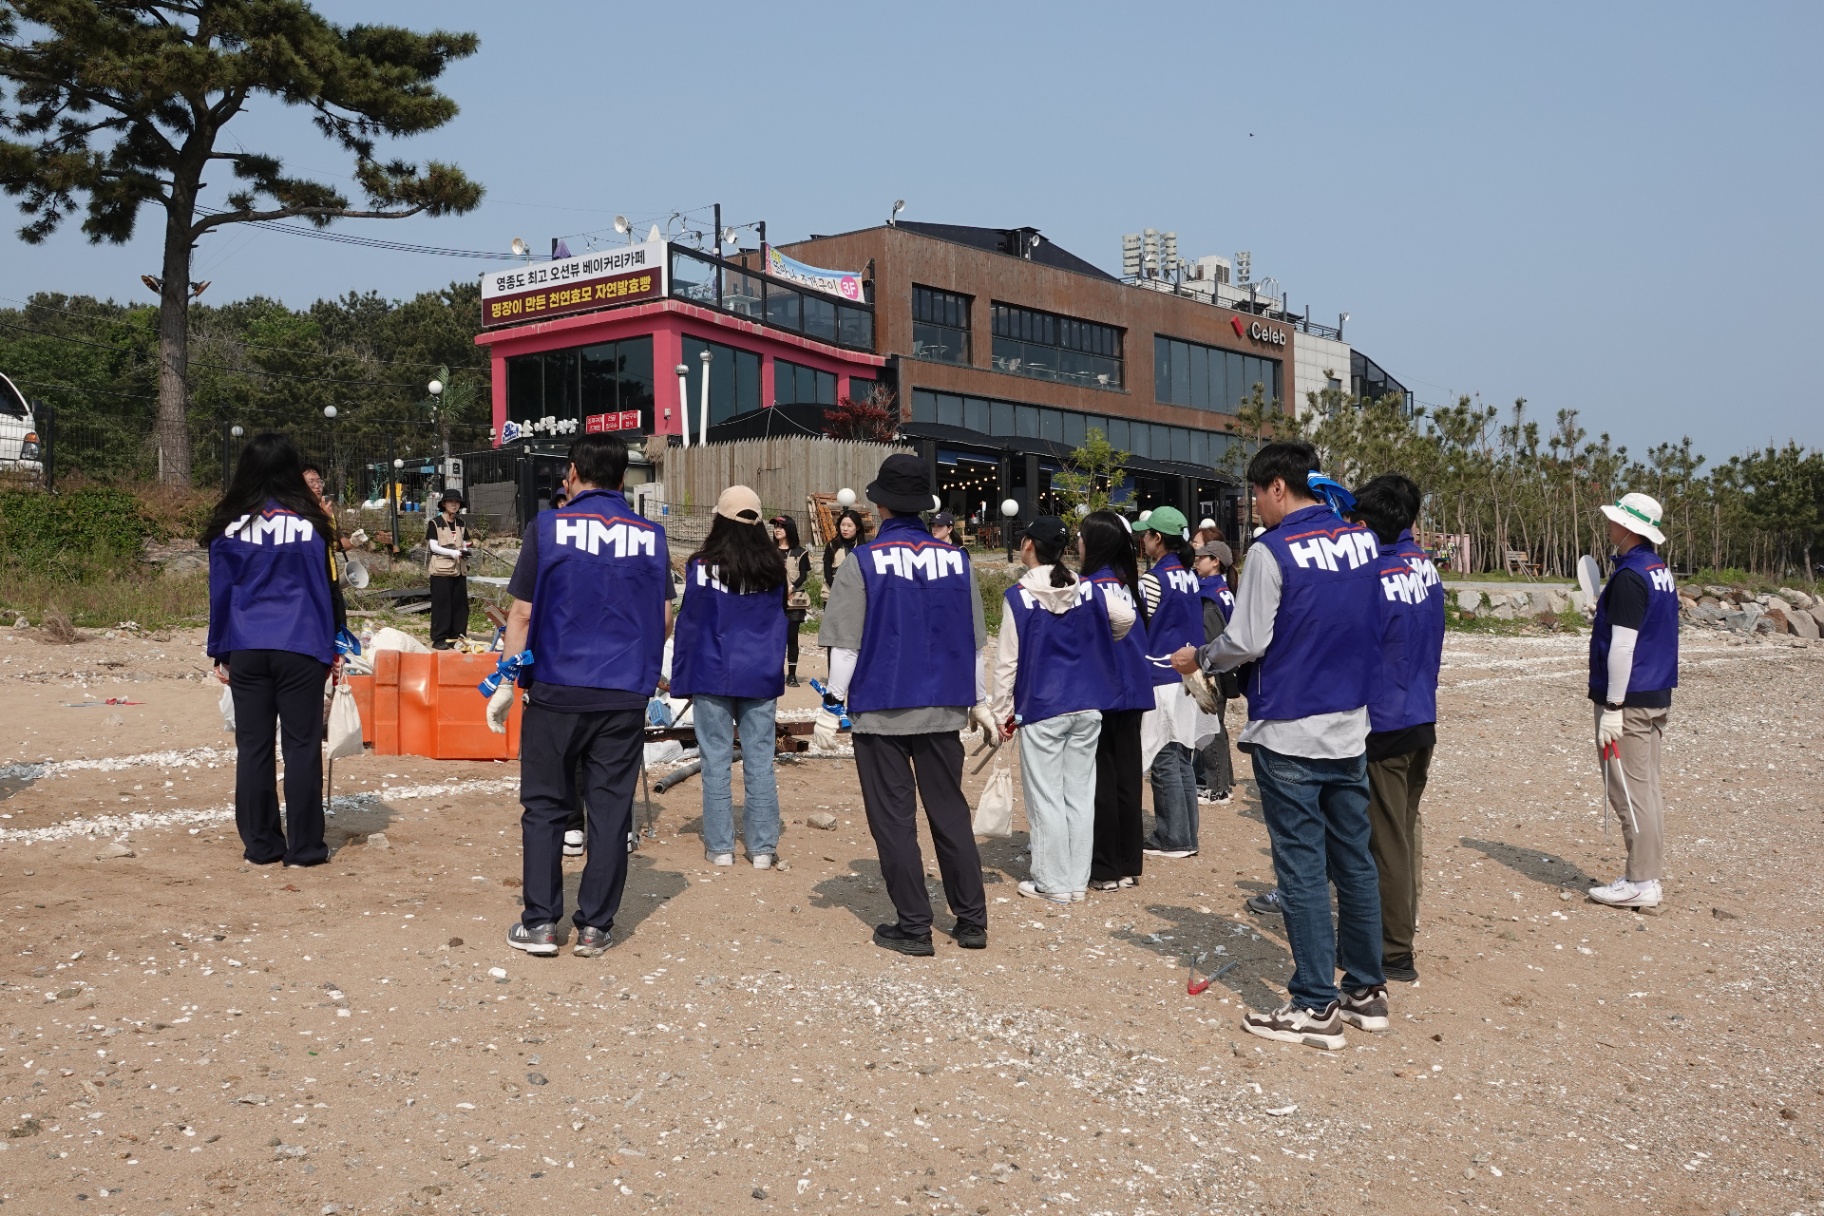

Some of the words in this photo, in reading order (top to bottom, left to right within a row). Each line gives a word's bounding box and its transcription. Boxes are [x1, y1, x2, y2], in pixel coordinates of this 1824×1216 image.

[496, 273, 526, 291] 영종도
[527, 269, 547, 285] 최고
[550, 263, 580, 280] 오션뷰
[582, 250, 645, 274] 베이커리카페
[491, 301, 522, 318] 명장이
[525, 294, 546, 311] 만든
[549, 286, 592, 308] 천연효모
[595, 275, 652, 299] 자연발효빵
[842, 281, 856, 296] 3F
[1251, 321, 1287, 346] Celeb
[225, 514, 313, 546] HMM
[556, 519, 656, 558] HMM
[872, 546, 963, 581] HMM
[1288, 532, 1379, 572] HMM
[1380, 572, 1429, 605] HMM
